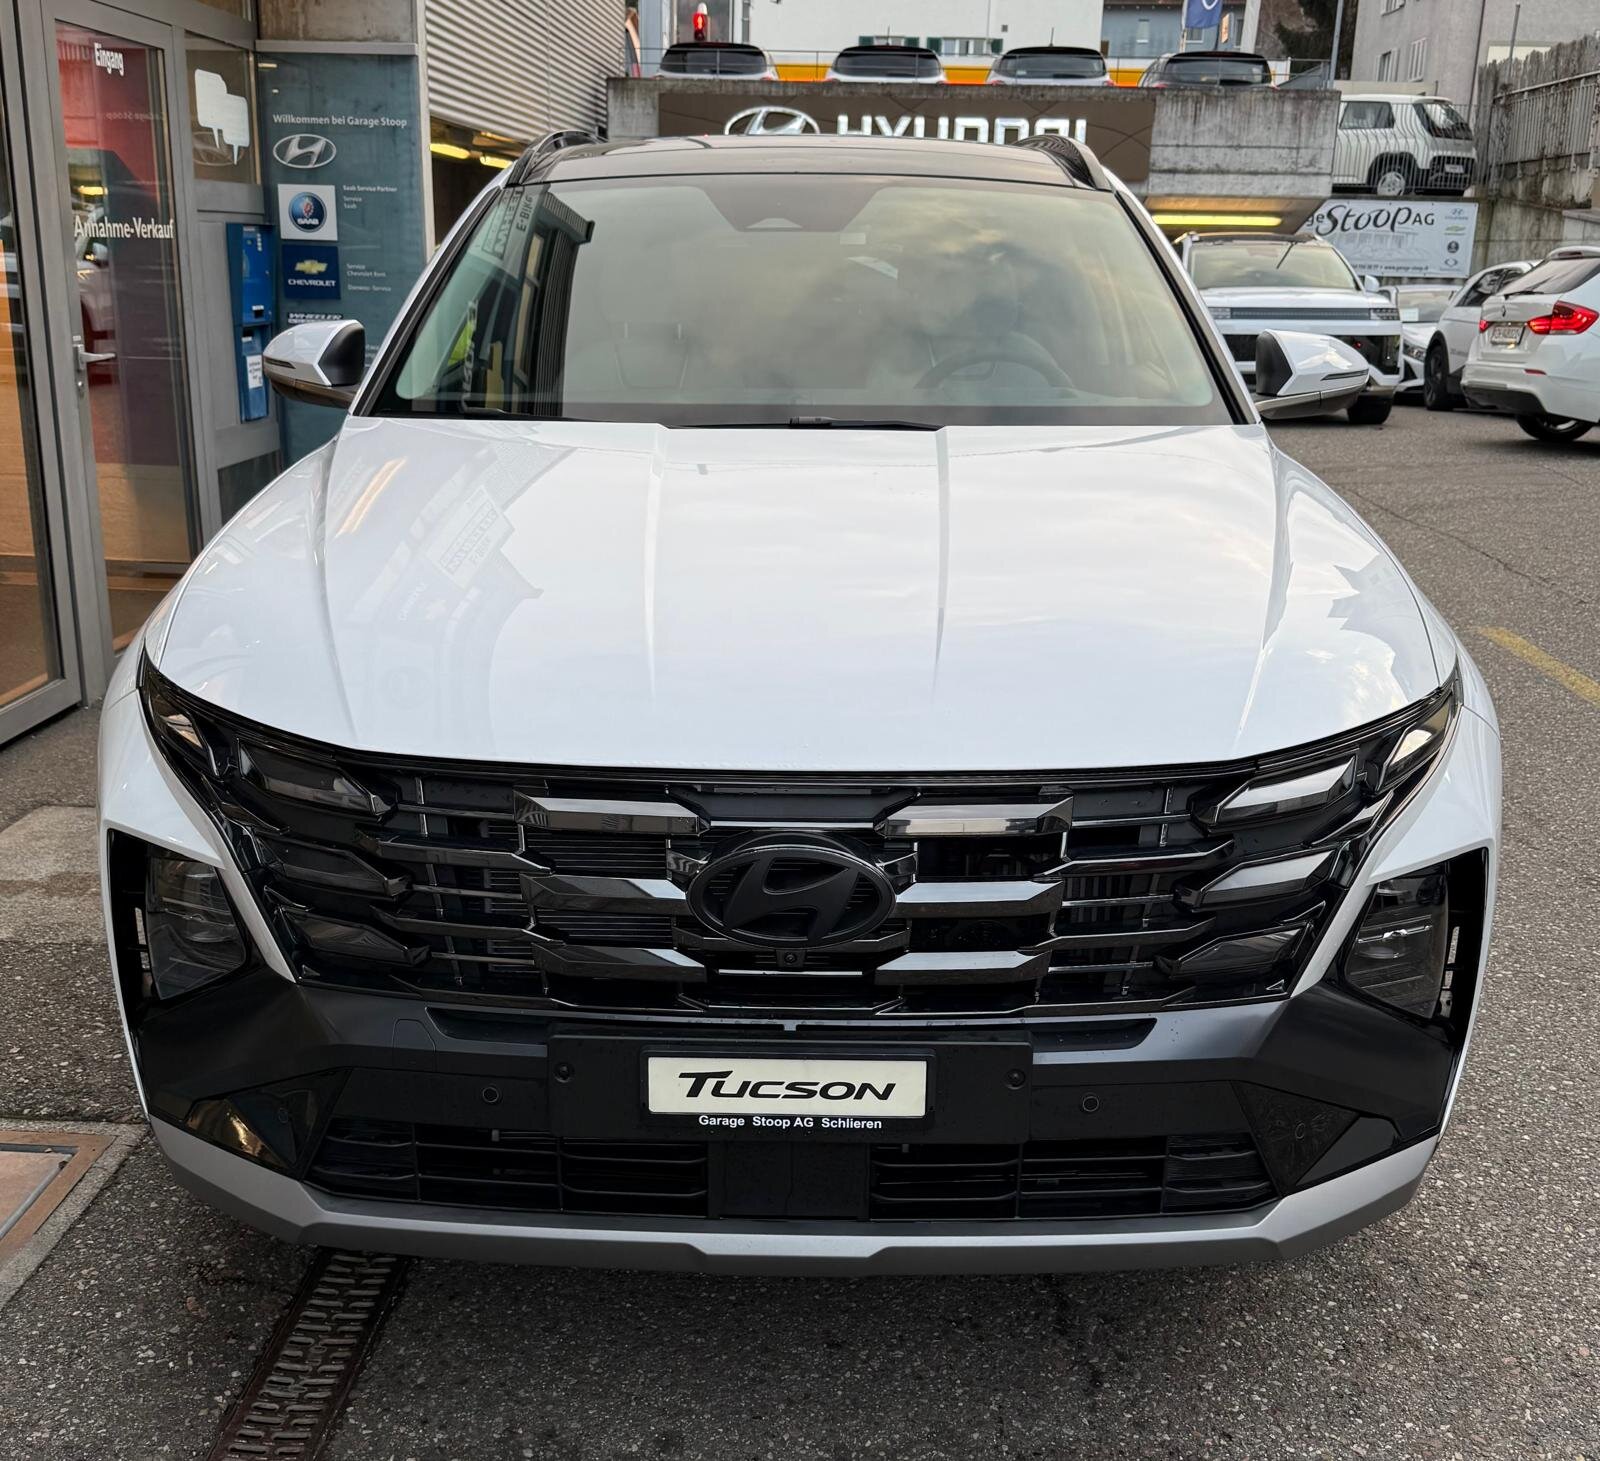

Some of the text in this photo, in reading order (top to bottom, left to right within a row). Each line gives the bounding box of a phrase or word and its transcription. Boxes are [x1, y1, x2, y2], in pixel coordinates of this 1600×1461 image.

[94, 42, 124, 76] Eingang
[272, 114, 408, 129] Willkommen bei Garage Stoop
[1411, 213, 1435, 226] AG
[74, 215, 174, 239] Annahme-Verkauf
[288, 278, 336, 287] CHEVROLET
[289, 312, 342, 320] WHEELER
[698, 1115, 882, 1129] Garage Stoop AG Schlieren
